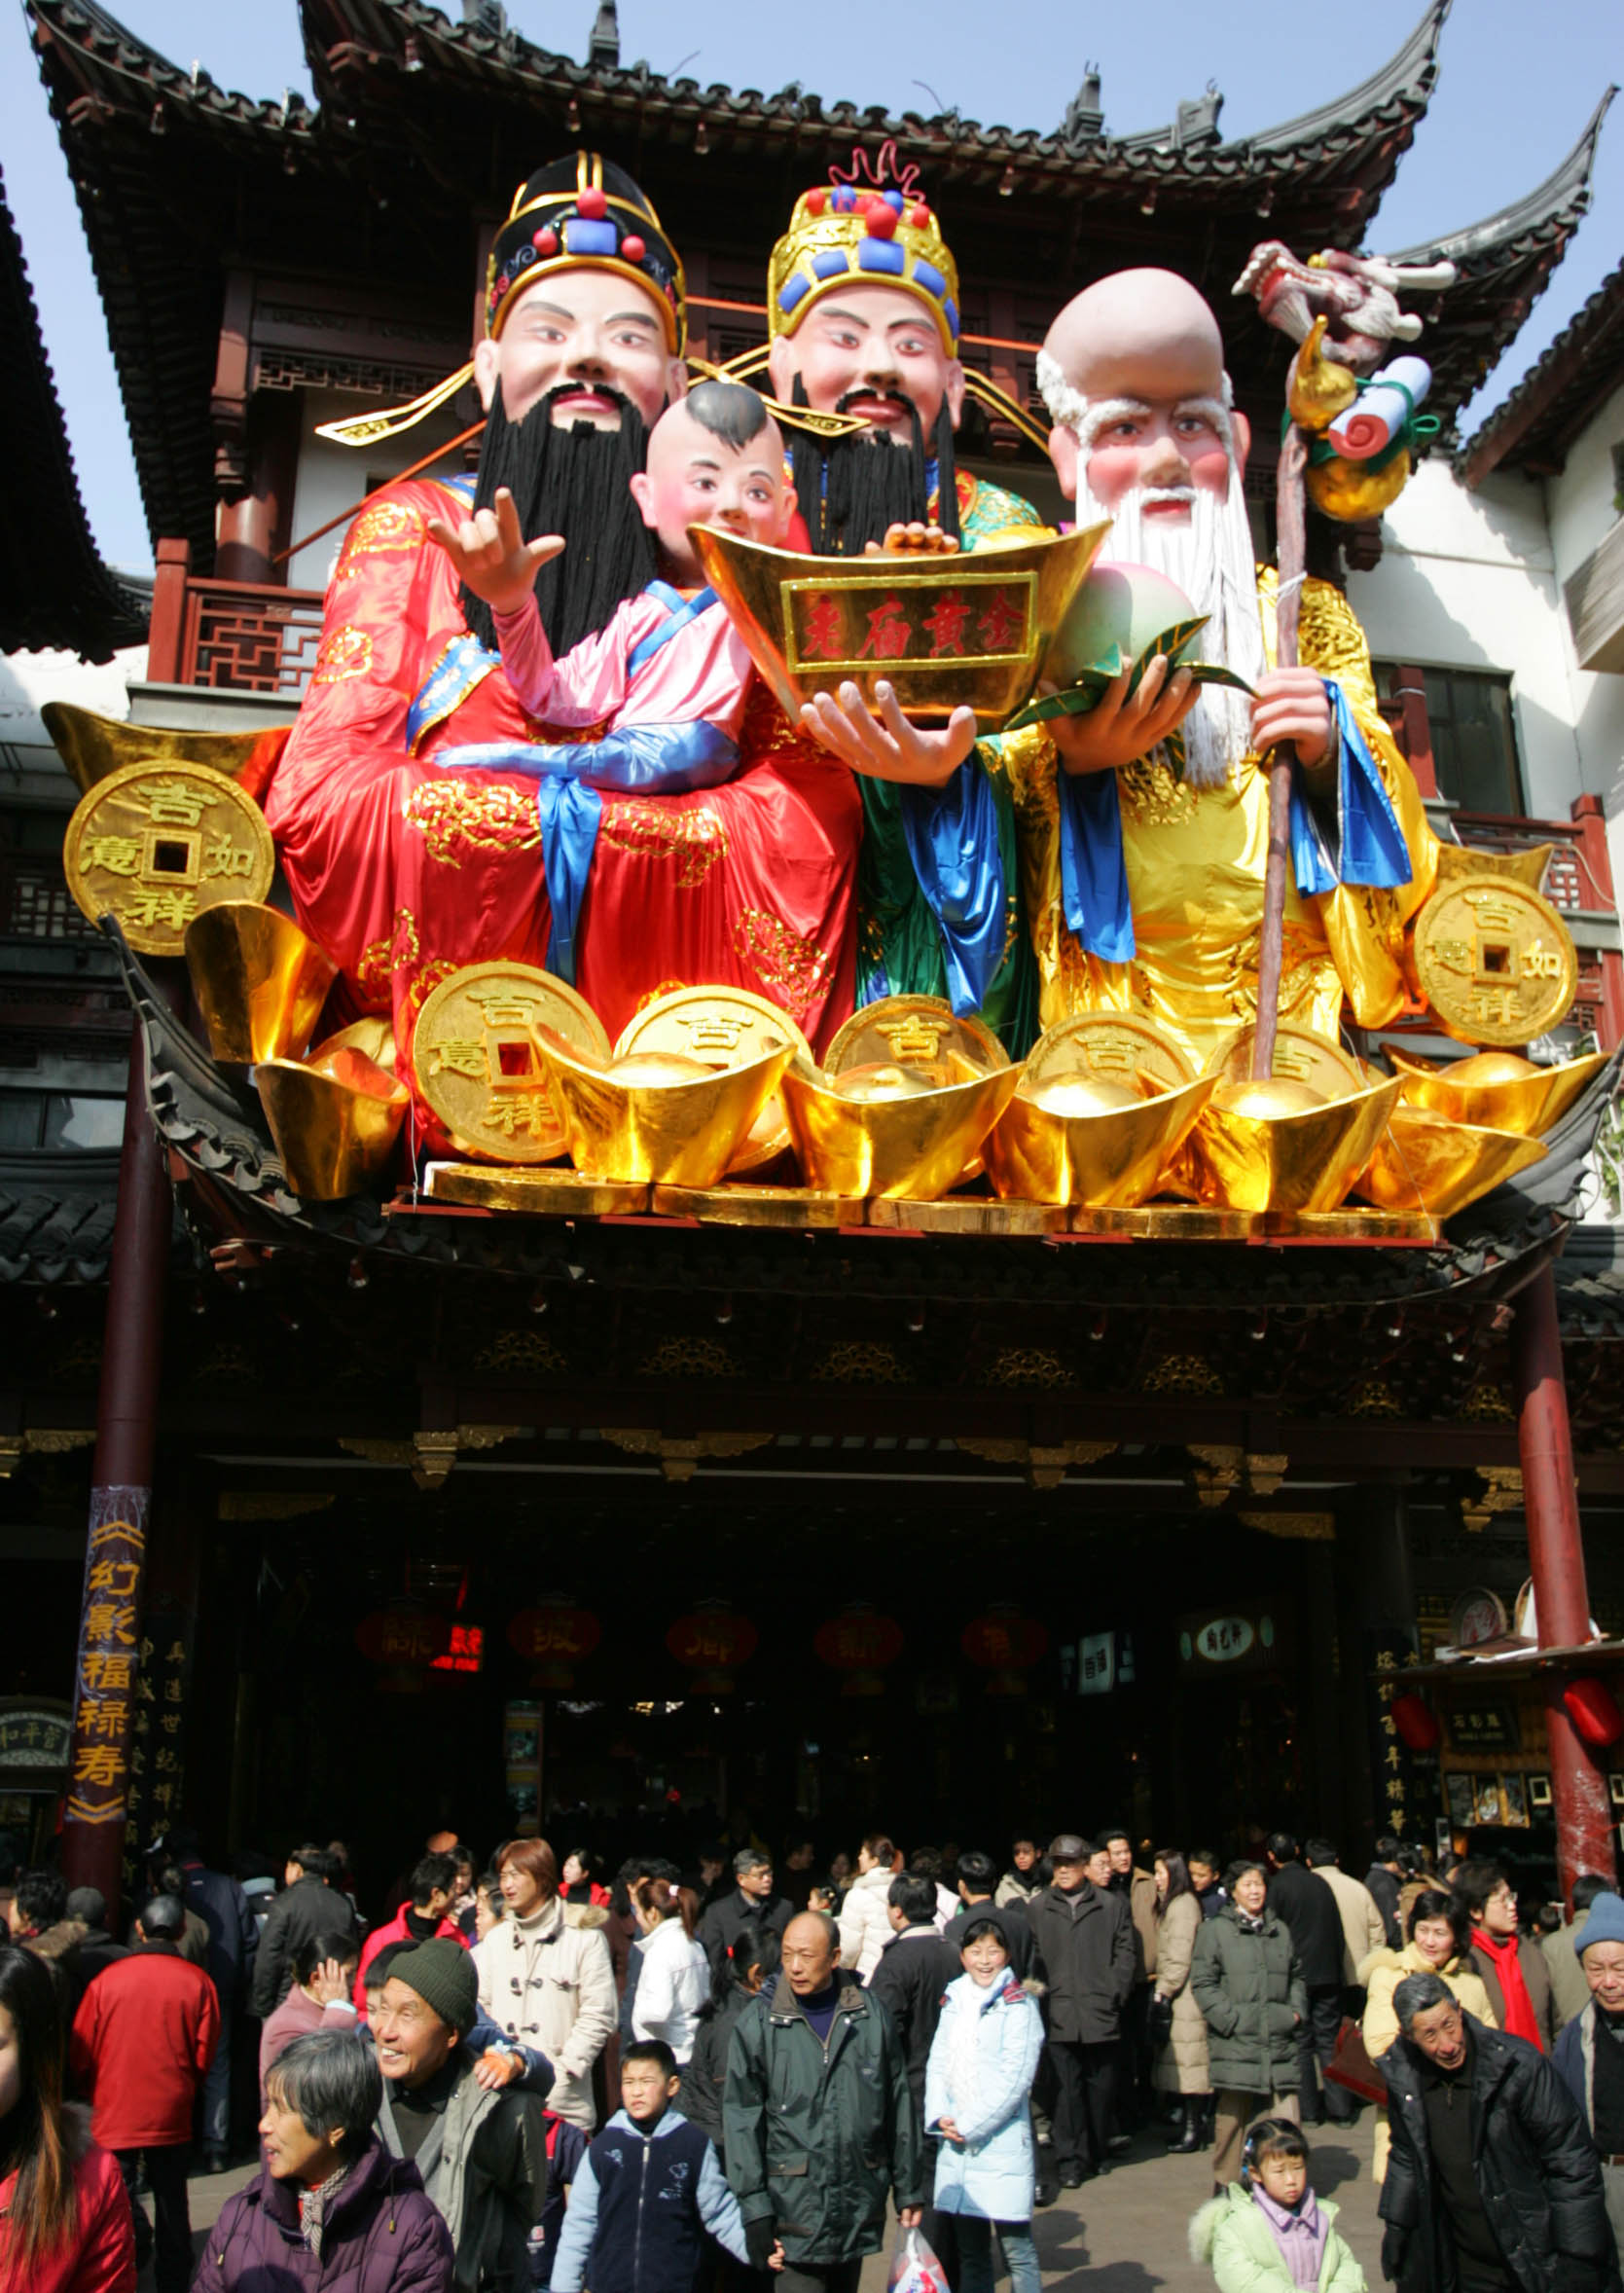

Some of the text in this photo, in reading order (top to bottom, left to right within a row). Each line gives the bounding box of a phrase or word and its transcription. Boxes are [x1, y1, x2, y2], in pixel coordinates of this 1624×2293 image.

[801, 590, 1025, 659] 老庙黄金
[138, 783, 218, 827] 吉
[80, 834, 254, 878] 意 如
[124, 891, 199, 931] 祥
[1463, 892, 1527, 932] 吉
[1519, 938, 1563, 979] 如
[467, 992, 546, 1028] 吉
[1470, 986, 1529, 1026] 祥
[676, 1009, 753, 1049] 吉
[876, 1014, 955, 1062] 吉
[427, 1037, 487, 1078] 意
[1073, 1033, 1144, 1072] 吉
[483, 1093, 559, 1137] 祥
